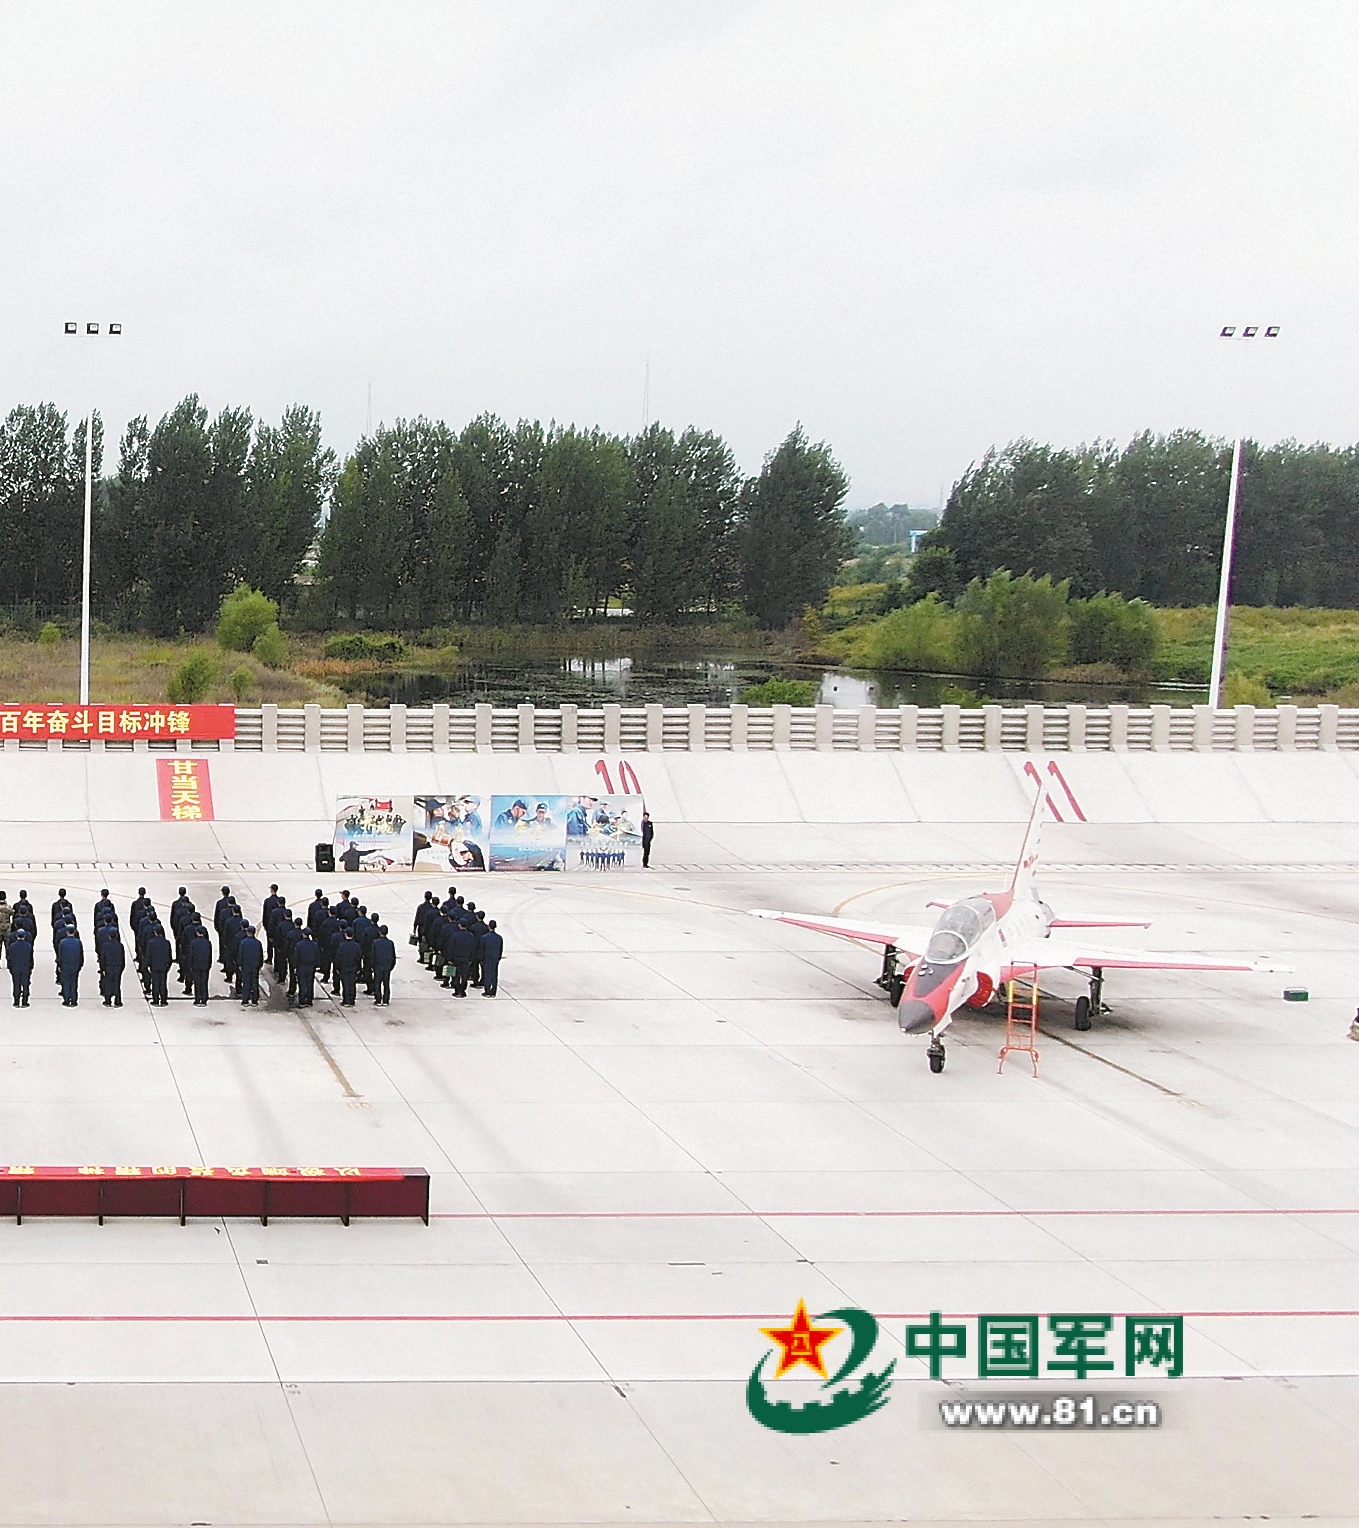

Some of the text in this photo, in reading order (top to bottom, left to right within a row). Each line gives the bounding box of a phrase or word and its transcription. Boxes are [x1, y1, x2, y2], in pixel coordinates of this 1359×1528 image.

[167, 760, 203, 820] 甘当天梯
[1023, 760, 1088, 823] 11
